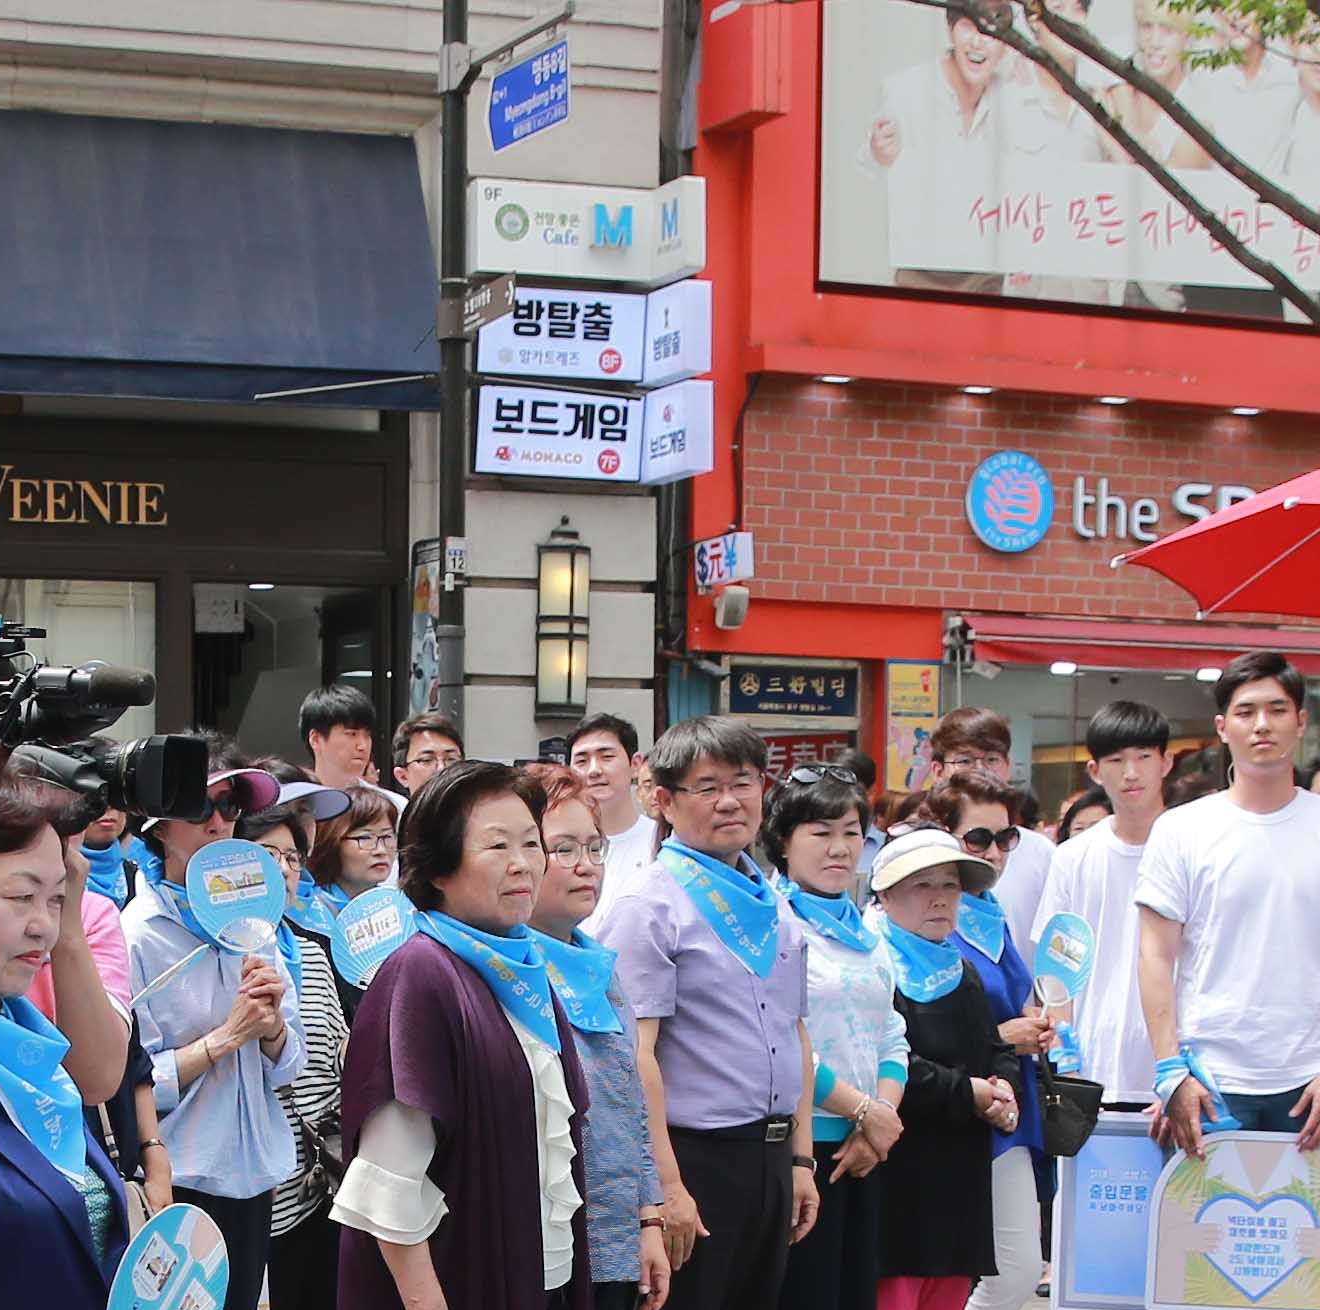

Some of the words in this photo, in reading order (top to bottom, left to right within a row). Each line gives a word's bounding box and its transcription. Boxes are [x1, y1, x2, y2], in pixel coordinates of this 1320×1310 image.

[484, 187, 503, 201] 9F
[594, 203, 632, 247] M
[662, 197, 678, 241] M
[969, 193, 1051, 244] 세상
[1067, 194, 1126, 246] 모든
[543, 227, 579, 245] Cafe
[512, 299, 613, 342] 방탈출
[600, 353, 620, 371] 8F
[492, 397, 629, 442] 보드게임
[520, 449, 583, 465] MONACO
[599, 454, 619, 470] 7F
[1072, 474, 1161, 542] the
[1089, 1184, 1148, 1200] 출입문을
